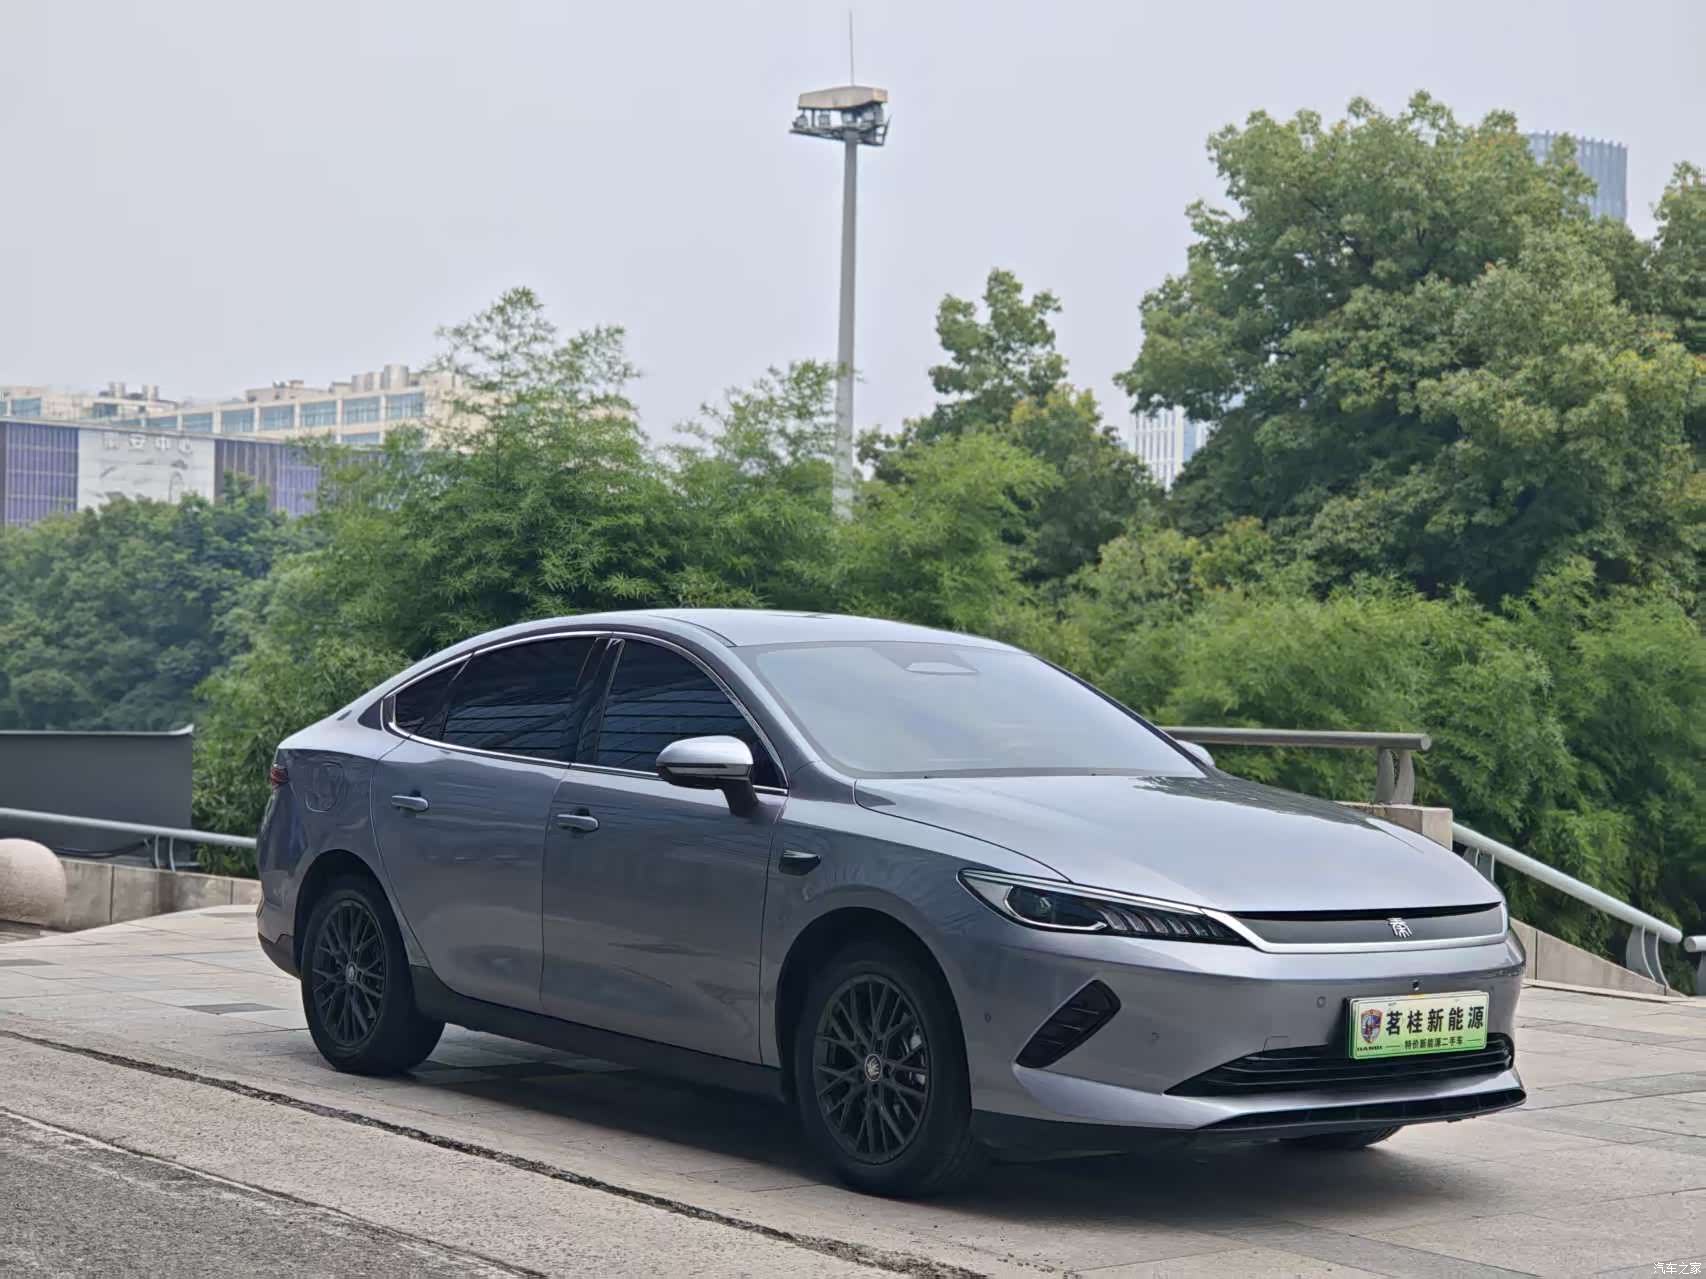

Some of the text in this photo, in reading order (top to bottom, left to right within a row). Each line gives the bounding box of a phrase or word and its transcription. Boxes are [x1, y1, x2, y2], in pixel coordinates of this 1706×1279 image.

[1385, 1005, 1485, 1036] 茗桂新能源
